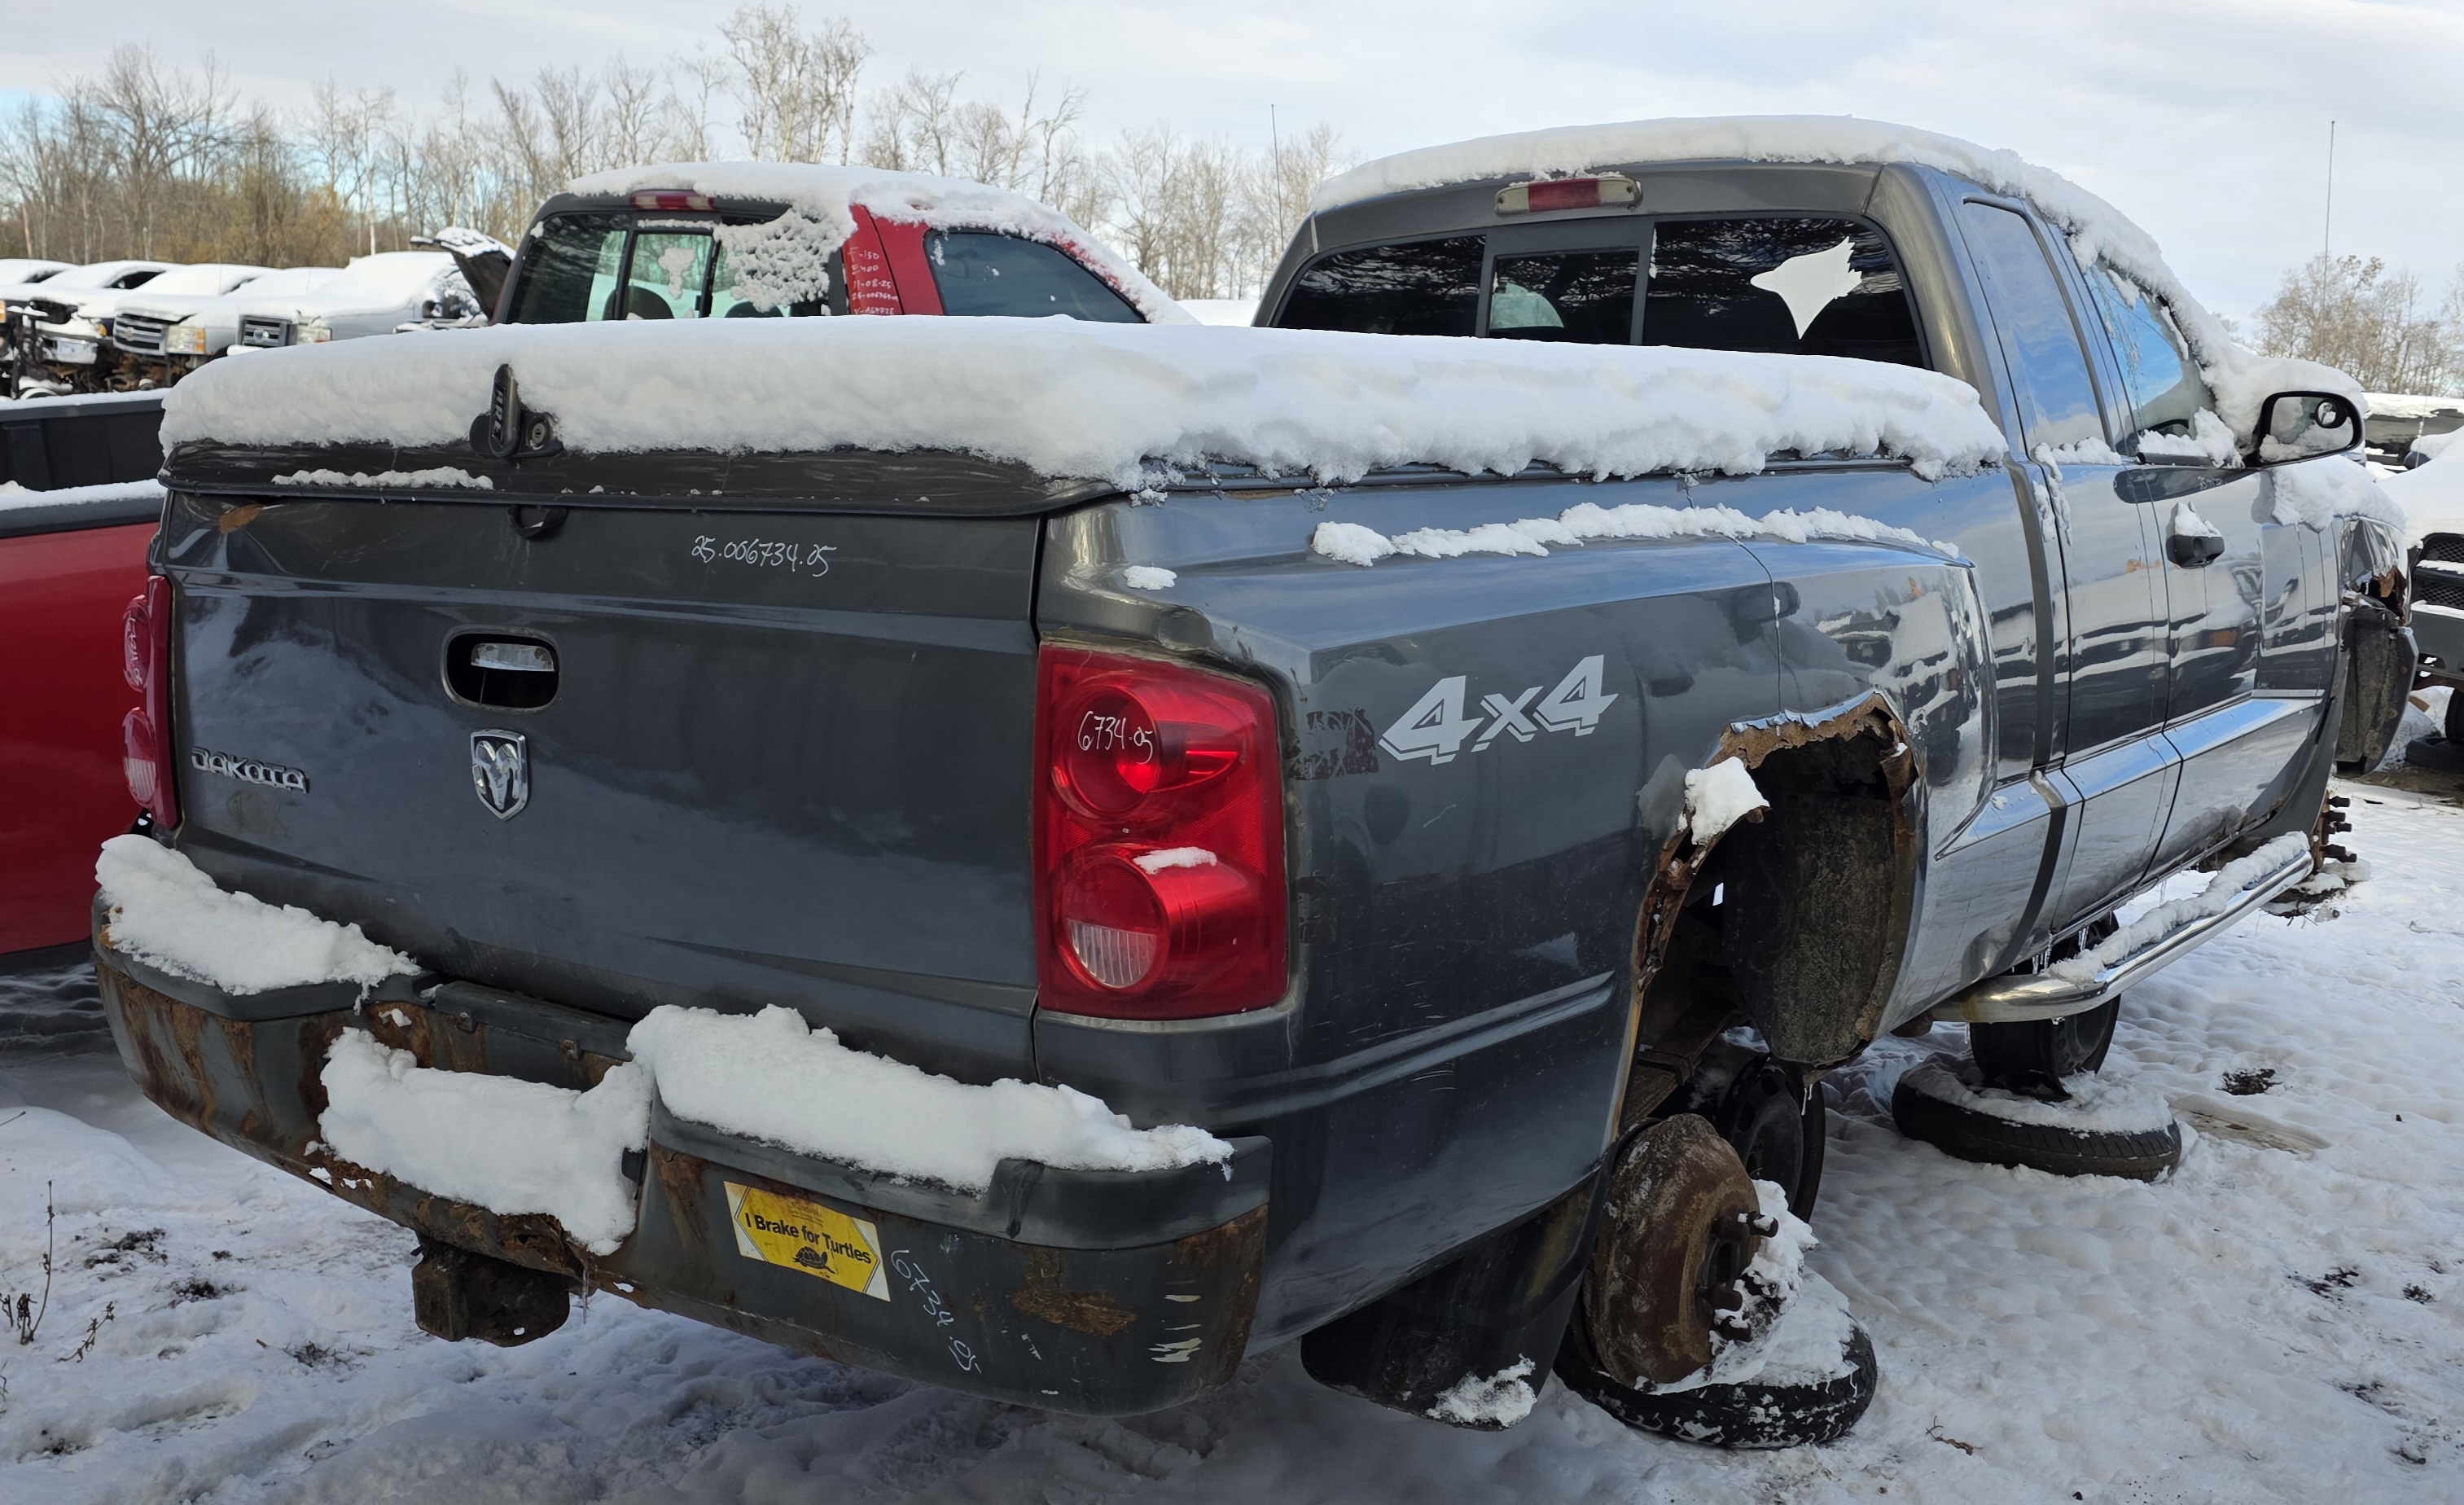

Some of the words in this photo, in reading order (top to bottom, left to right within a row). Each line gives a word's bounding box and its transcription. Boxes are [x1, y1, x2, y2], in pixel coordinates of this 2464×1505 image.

[848, 247, 879, 261] F-150
[853, 279, 891, 289] 11-08-25
[493, 388, 503, 432] ARE
[691, 535, 837, 577] 25.006734.05
[1379, 654, 1619, 766] 4x4
[745, 1213, 752, 1227] I
[754, 1214, 799, 1238] Brake
[801, 1225, 820, 1245] for
[822, 1232, 871, 1264] Turtles
